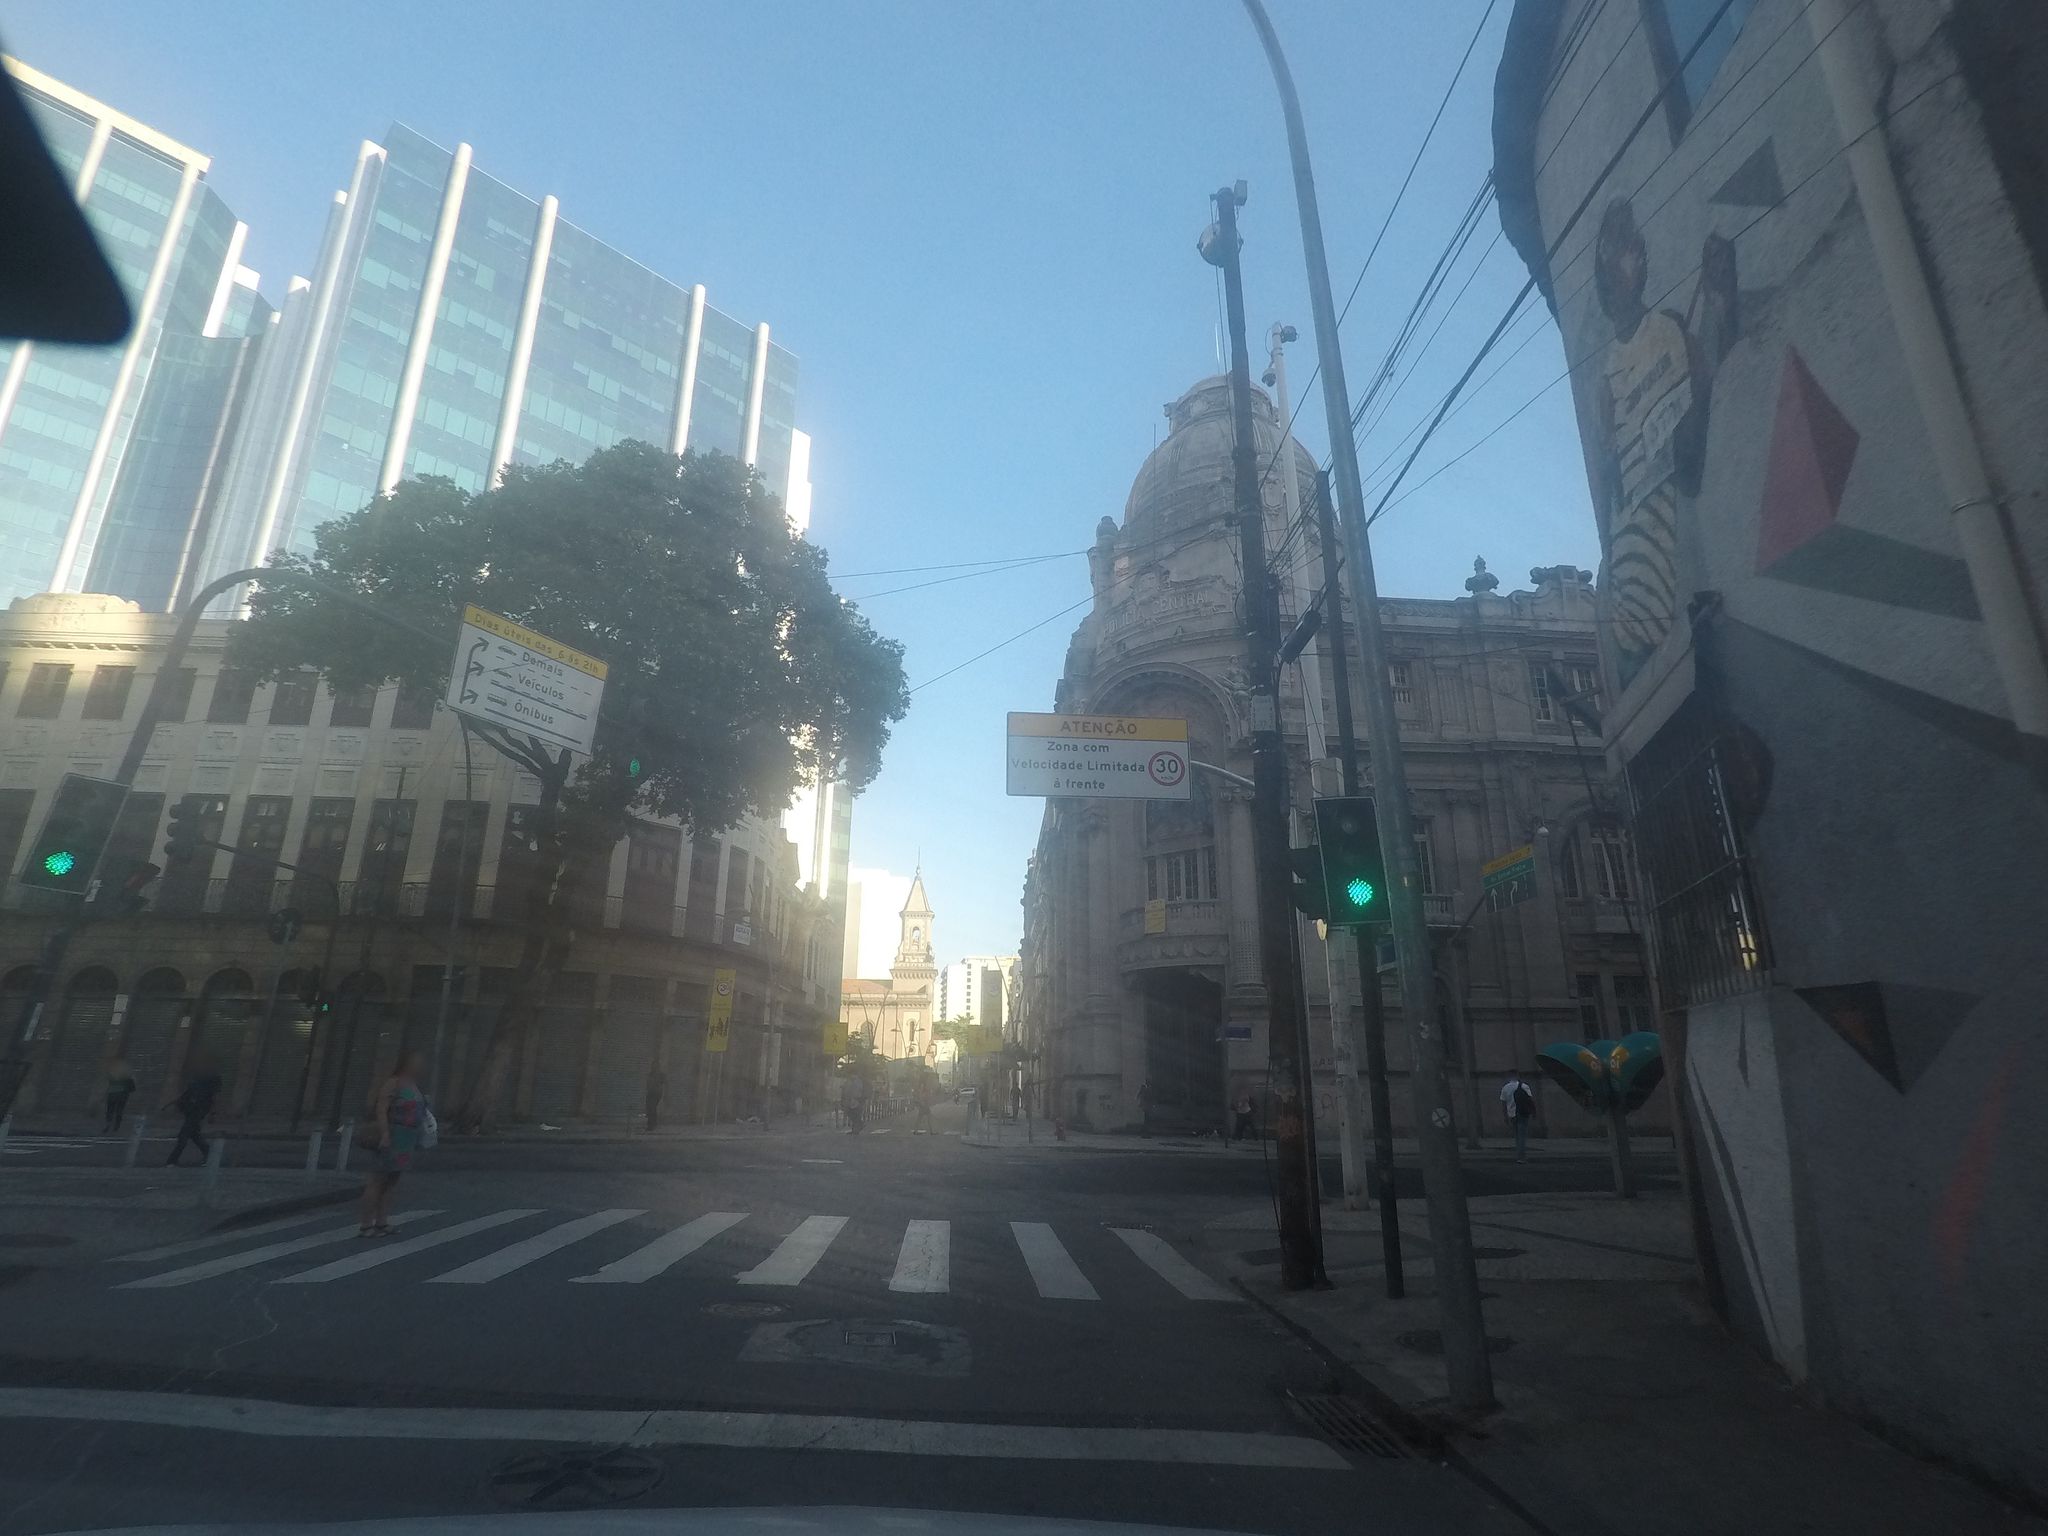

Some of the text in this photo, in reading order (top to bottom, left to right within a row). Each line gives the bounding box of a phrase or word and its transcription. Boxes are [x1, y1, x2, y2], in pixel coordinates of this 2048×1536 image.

[475, 613, 499, 630] Dias
[522, 651, 564, 677] Demais
[518, 673, 565, 700] Veículos
[514, 699, 554, 724] Ônibus
[1060, 719, 1138, 736] ATENÇÃO
[1047, 741, 1109, 752] Zona com
[1011, 758, 1145, 772] Velocidade Limitada
[1156, 758, 1179, 774] 30
[1066, 778, 1105, 790] frente
